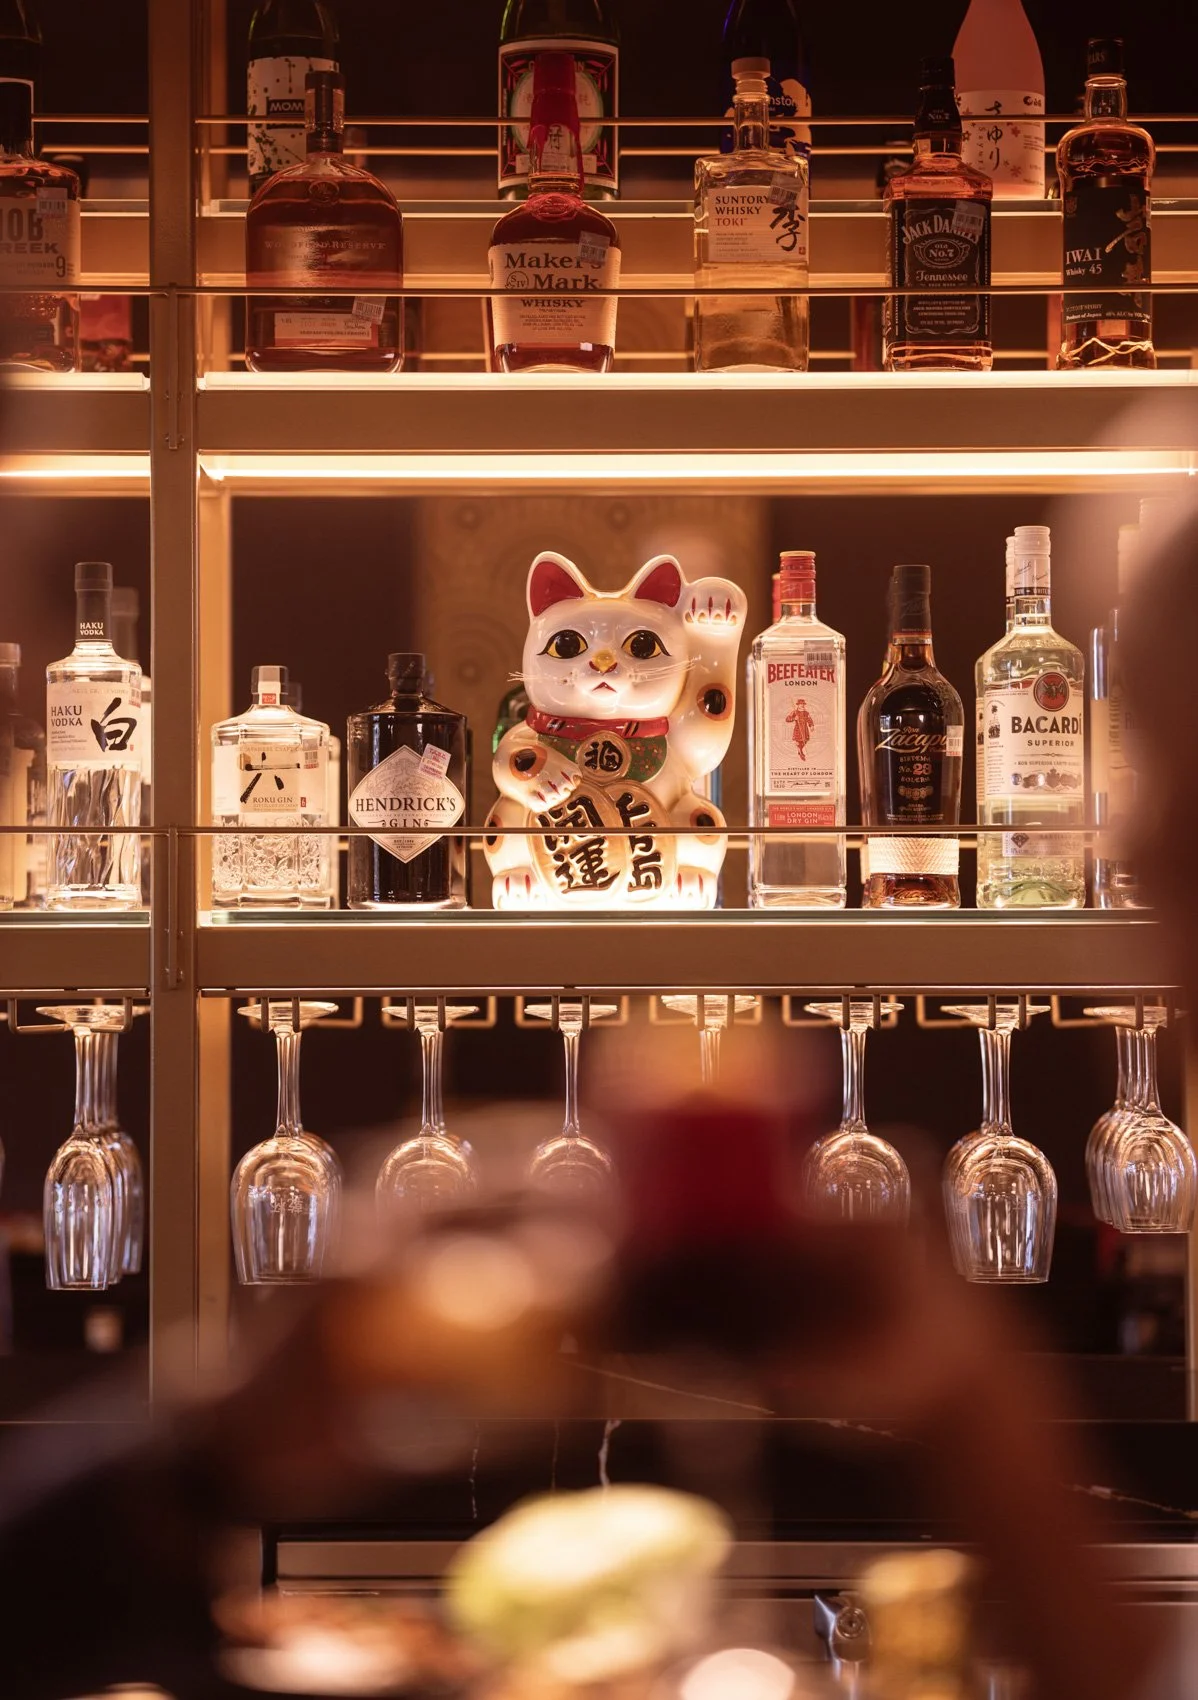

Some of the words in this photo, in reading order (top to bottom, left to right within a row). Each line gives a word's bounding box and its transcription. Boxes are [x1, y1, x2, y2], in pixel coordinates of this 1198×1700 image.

[715, 195, 770, 205] SUNTORY
[715, 206, 762, 215] WHISKY
[0, 207, 43, 241] OB
[715, 217, 744, 226] TOKI
[902, 220, 933, 244] JACK
[928, 249, 954, 258] No.7
[1065, 247, 1103, 265] IWAI
[55, 255, 66, 278] 9
[1065, 267, 1086, 277] Whisky
[1088, 264, 1103, 275] 45
[533, 273, 598, 290] Mark
[915, 270, 968, 282] Tennessee
[520, 299, 584, 308] WHISKY
[767, 662, 835, 684] BEEFEATER
[51, 705, 82, 717] HAKU
[51, 717, 83, 727] VODKA
[90, 697, 137, 753] 白
[1027, 739, 1074, 747] SUPERIOR
[912, 762, 932, 775] 23
[240, 752, 301, 804] 六
[355, 797, 456, 812] HENDRICK'S
[389, 818, 422, 828] GIN
